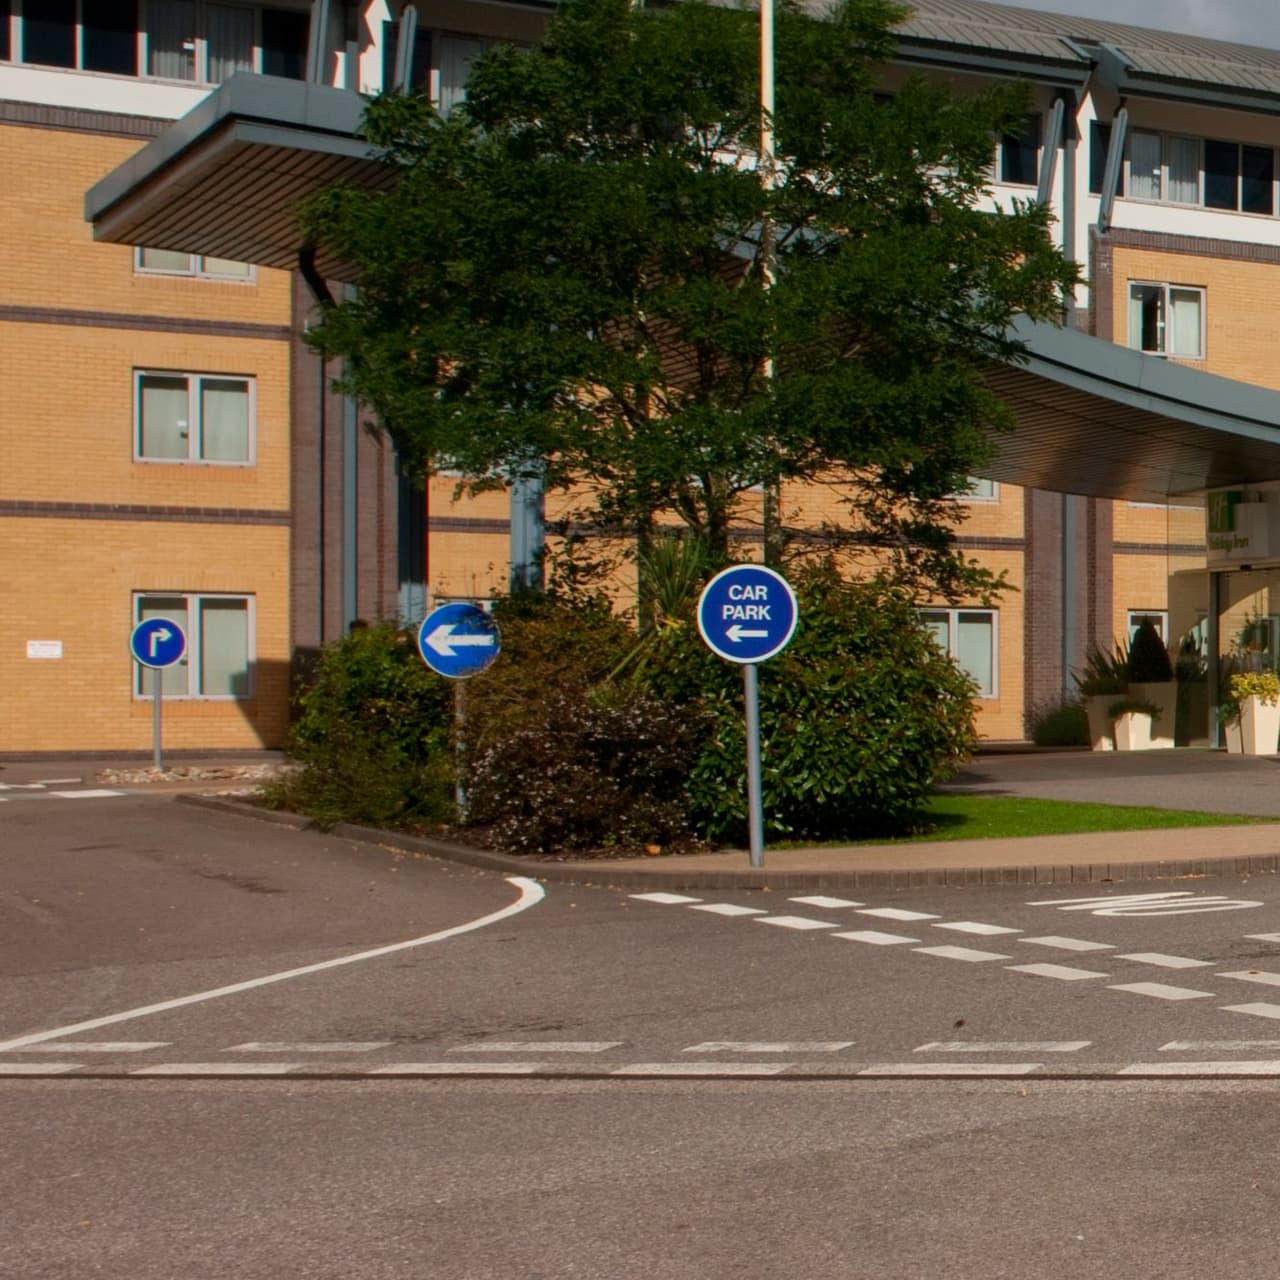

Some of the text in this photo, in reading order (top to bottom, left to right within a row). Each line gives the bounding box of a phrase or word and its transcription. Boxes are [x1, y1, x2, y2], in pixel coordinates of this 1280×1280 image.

[728, 584, 768, 601] CAR
[722, 604, 771, 620] PARK
[1024, 891, 1264, 916] NO
